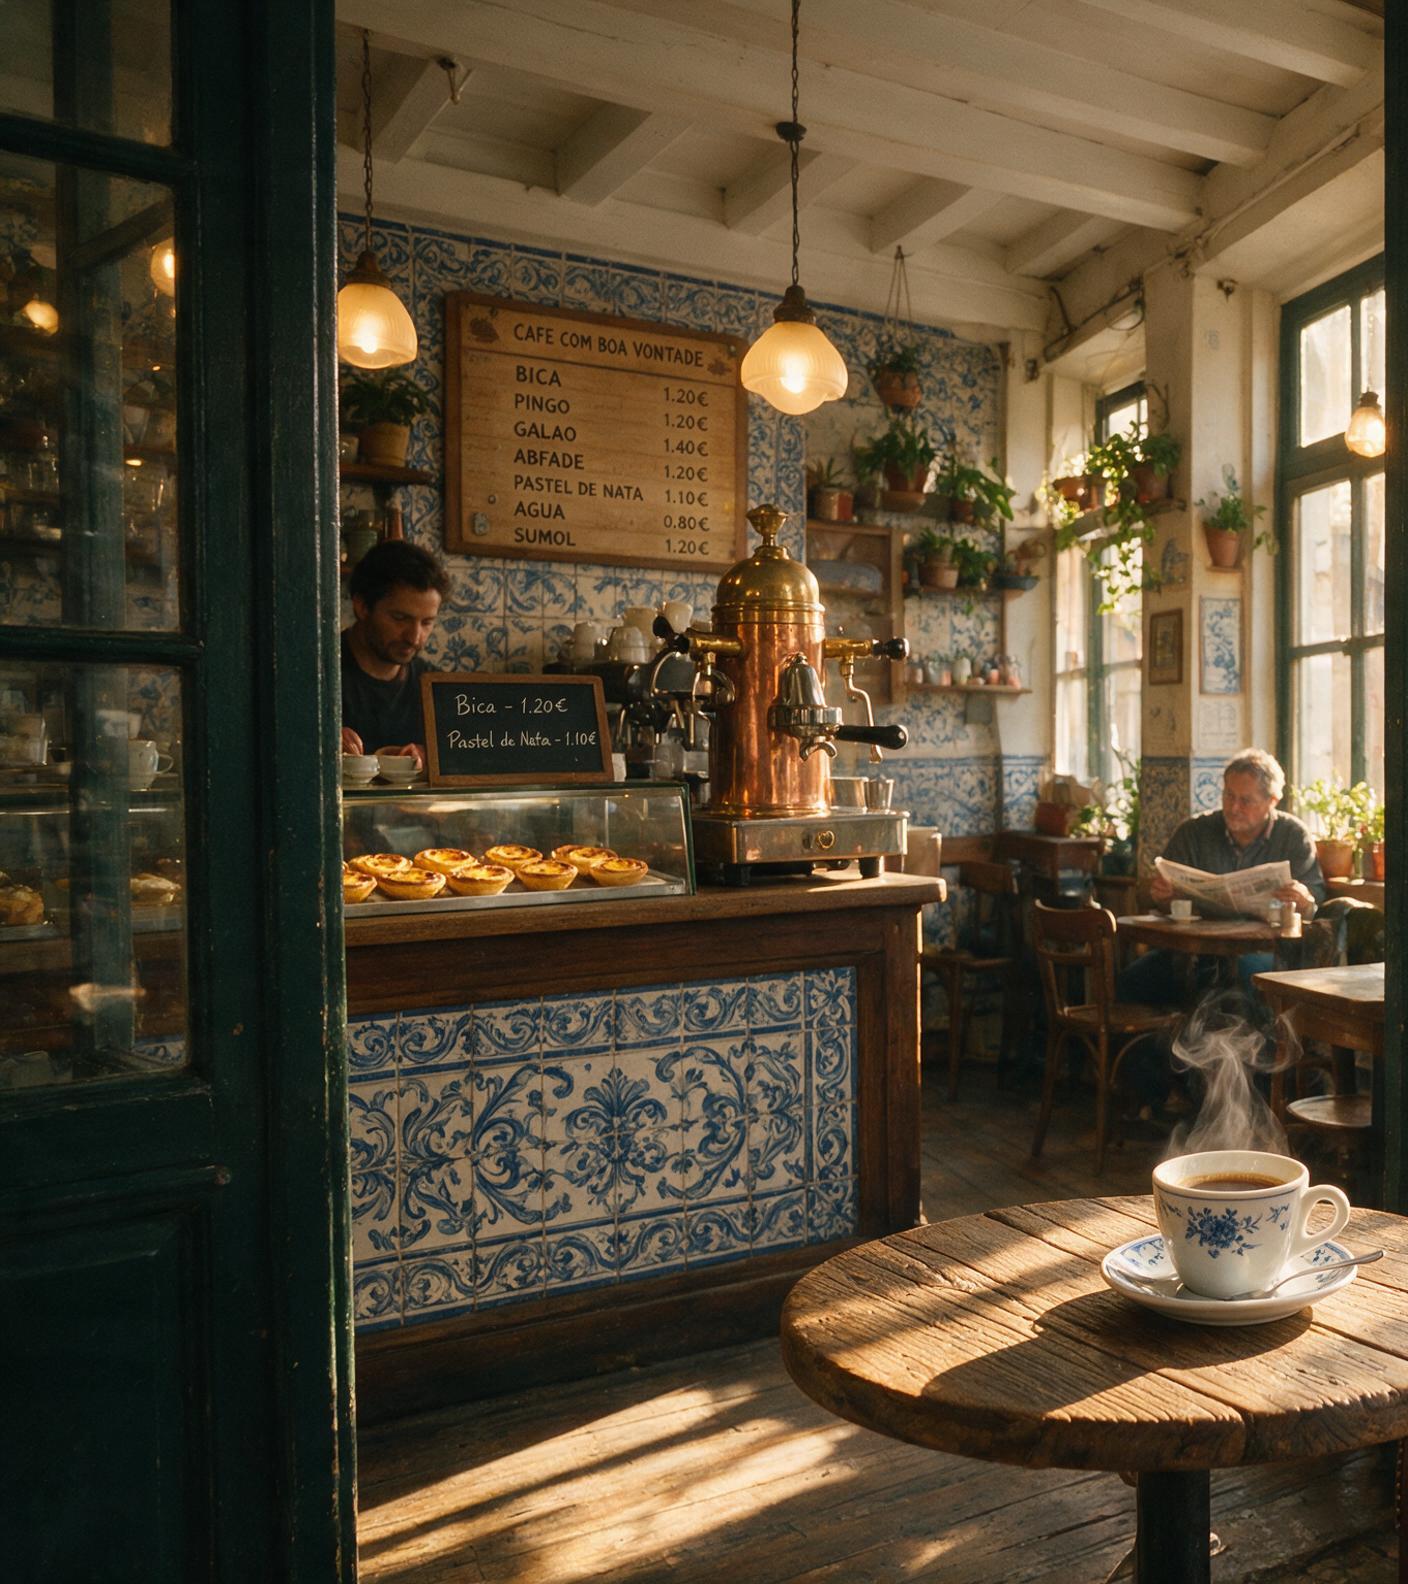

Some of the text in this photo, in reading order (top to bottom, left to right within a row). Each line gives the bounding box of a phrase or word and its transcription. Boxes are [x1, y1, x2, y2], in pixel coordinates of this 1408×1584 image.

[513, 323, 704, 368] CAFE COM BOA VONTADE
[515, 365, 710, 407] BICA 1.20€
[514, 393, 710, 432] PINGO 1.20€
[513, 420, 709, 457] GALAO 1.40€
[513, 447, 709, 482] ABFADE 1.20€
[514, 474, 709, 507] PASTEL DE NATA 1.10€
[513, 501, 711, 532] AGUA 0.80€
[514, 527, 710, 556] SUMOL 1.20€
[455, 694, 497, 717] Bica
[520, 698, 569, 715] 1.20€
[447, 729, 494, 750] Pastel
[500, 731, 516, 748] de
[520, 731, 551, 748] Nata
[566, 731, 597, 746] 1.10€
